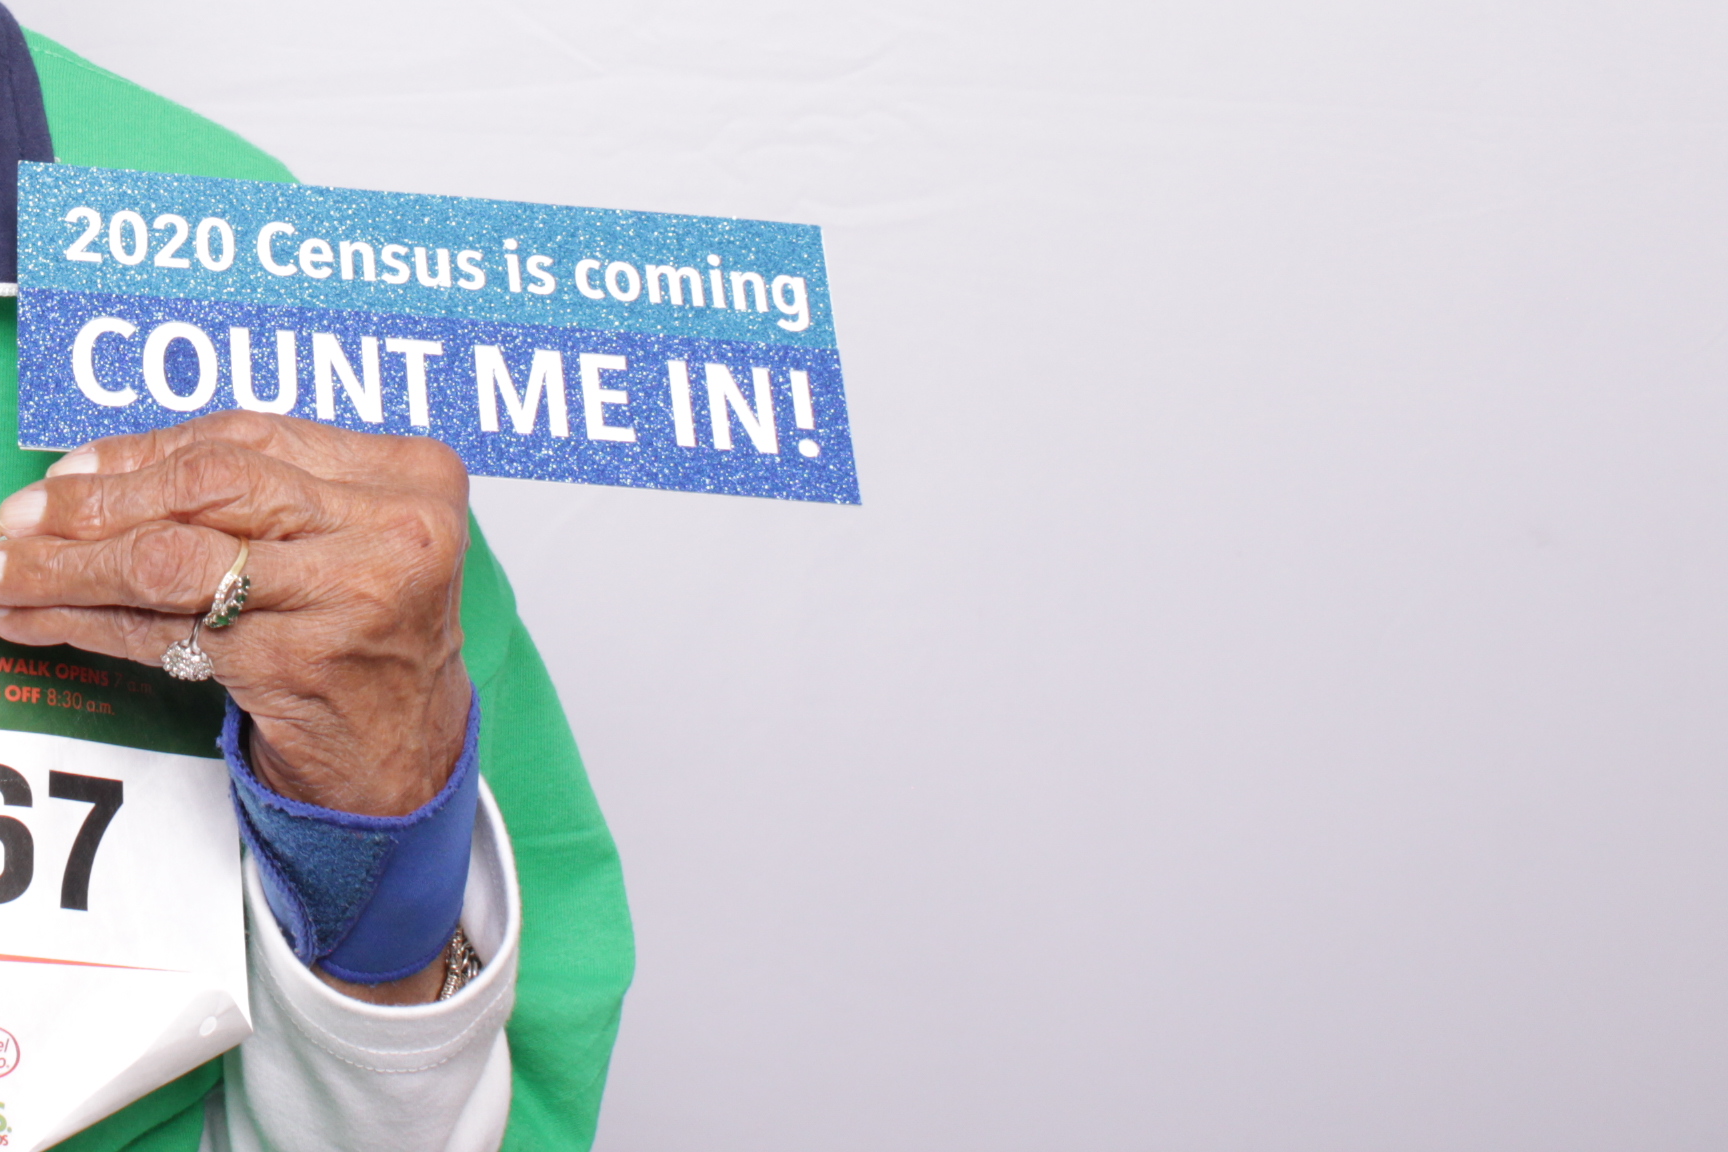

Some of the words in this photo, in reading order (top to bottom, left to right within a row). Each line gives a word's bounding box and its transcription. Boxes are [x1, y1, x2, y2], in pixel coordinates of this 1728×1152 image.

[63, 206, 234, 273] 2020
[256, 221, 485, 291] Census
[503, 238, 557, 297] is
[574, 254, 813, 333] coming
[70, 315, 444, 428] COUNT
[475, 344, 637, 445] ME
[668, 359, 822, 460] IN!
[4, 684, 41, 705] OFF
[46, 688, 83, 710] 8:30
[85, 698, 116, 716] a.m.
[54, 663, 110, 687] OPENS
